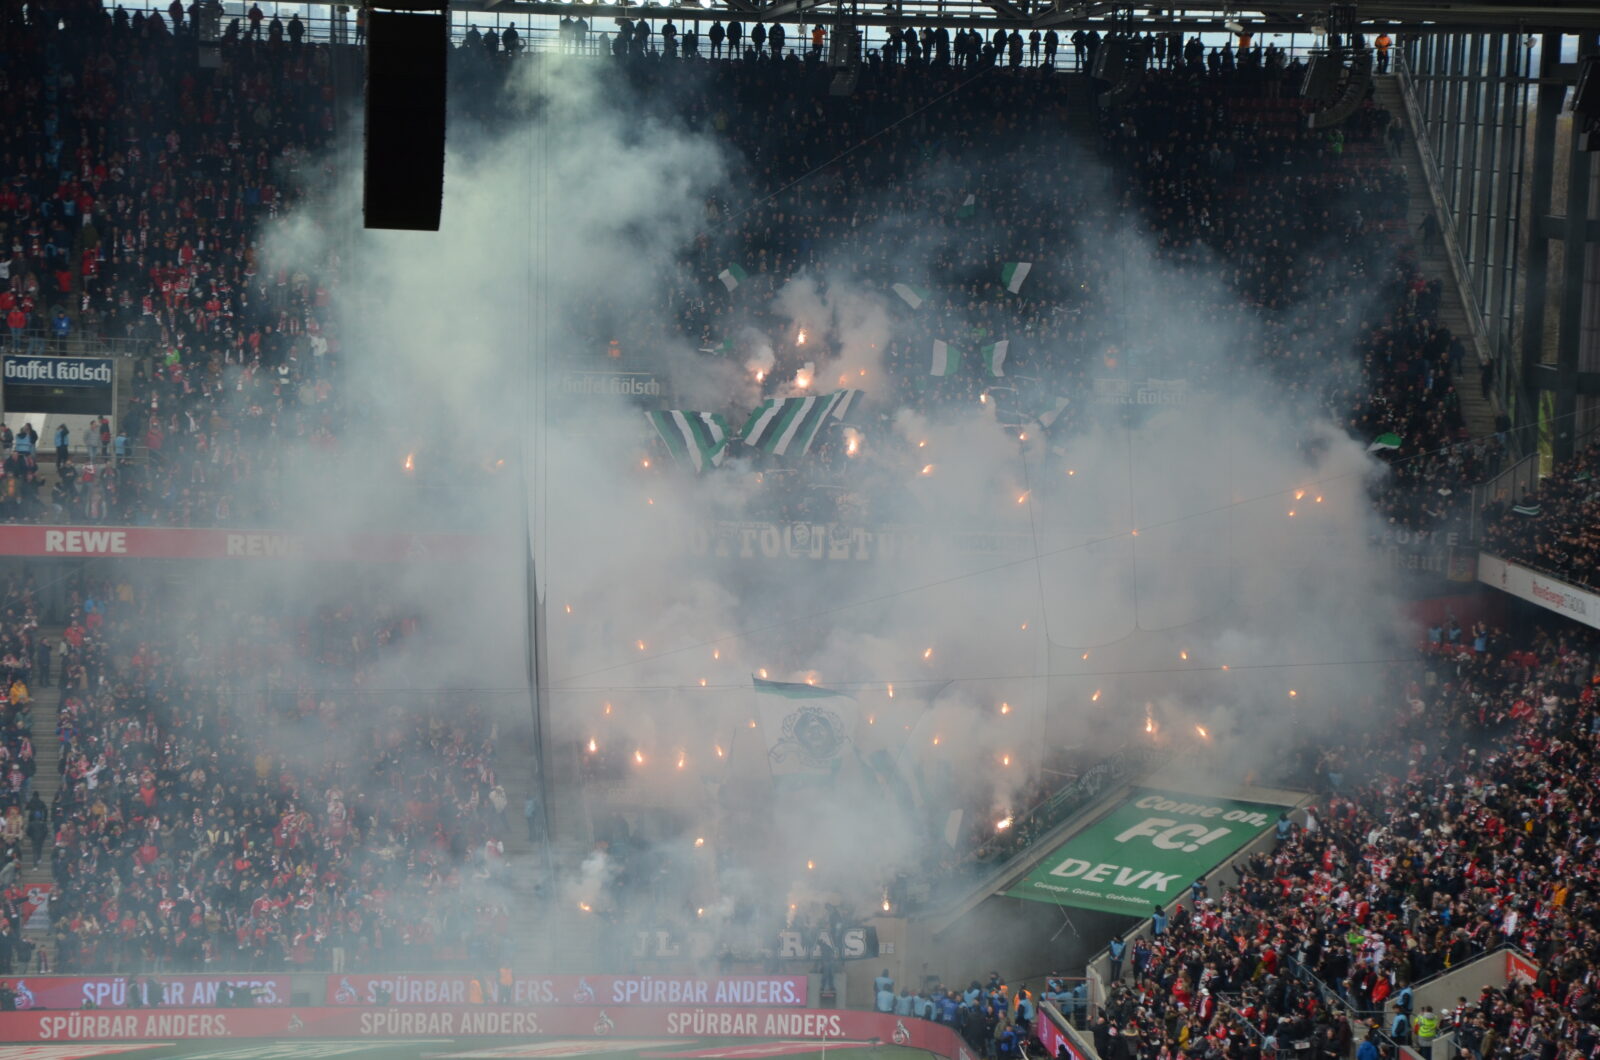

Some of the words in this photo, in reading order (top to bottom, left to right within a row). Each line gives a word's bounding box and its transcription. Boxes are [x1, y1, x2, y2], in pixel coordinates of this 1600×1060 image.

[4, 360, 53, 381] Gaffel
[56, 360, 111, 384] Kölsch
[45, 530, 127, 554] REWE
[1134, 795, 1223, 819] Come
[1222, 809, 1268, 827] on,
[1113, 817, 1232, 853] FC!
[1048, 858, 1183, 893] DEVK
[82, 978, 185, 1006] SPÜAR
[612, 975, 708, 1004] SPÜRBAR
[715, 980, 801, 1004] ANDERS.
[39, 1012, 137, 1039] SPÜRBAR
[144, 1014, 232, 1038] ANDERS.
[360, 1008, 453, 1034] SPÜRBAR
[460, 1012, 543, 1034] ANDERS.
[667, 1009, 757, 1036] SPÜRBAR
[764, 1013, 846, 1037] ANDERS.
